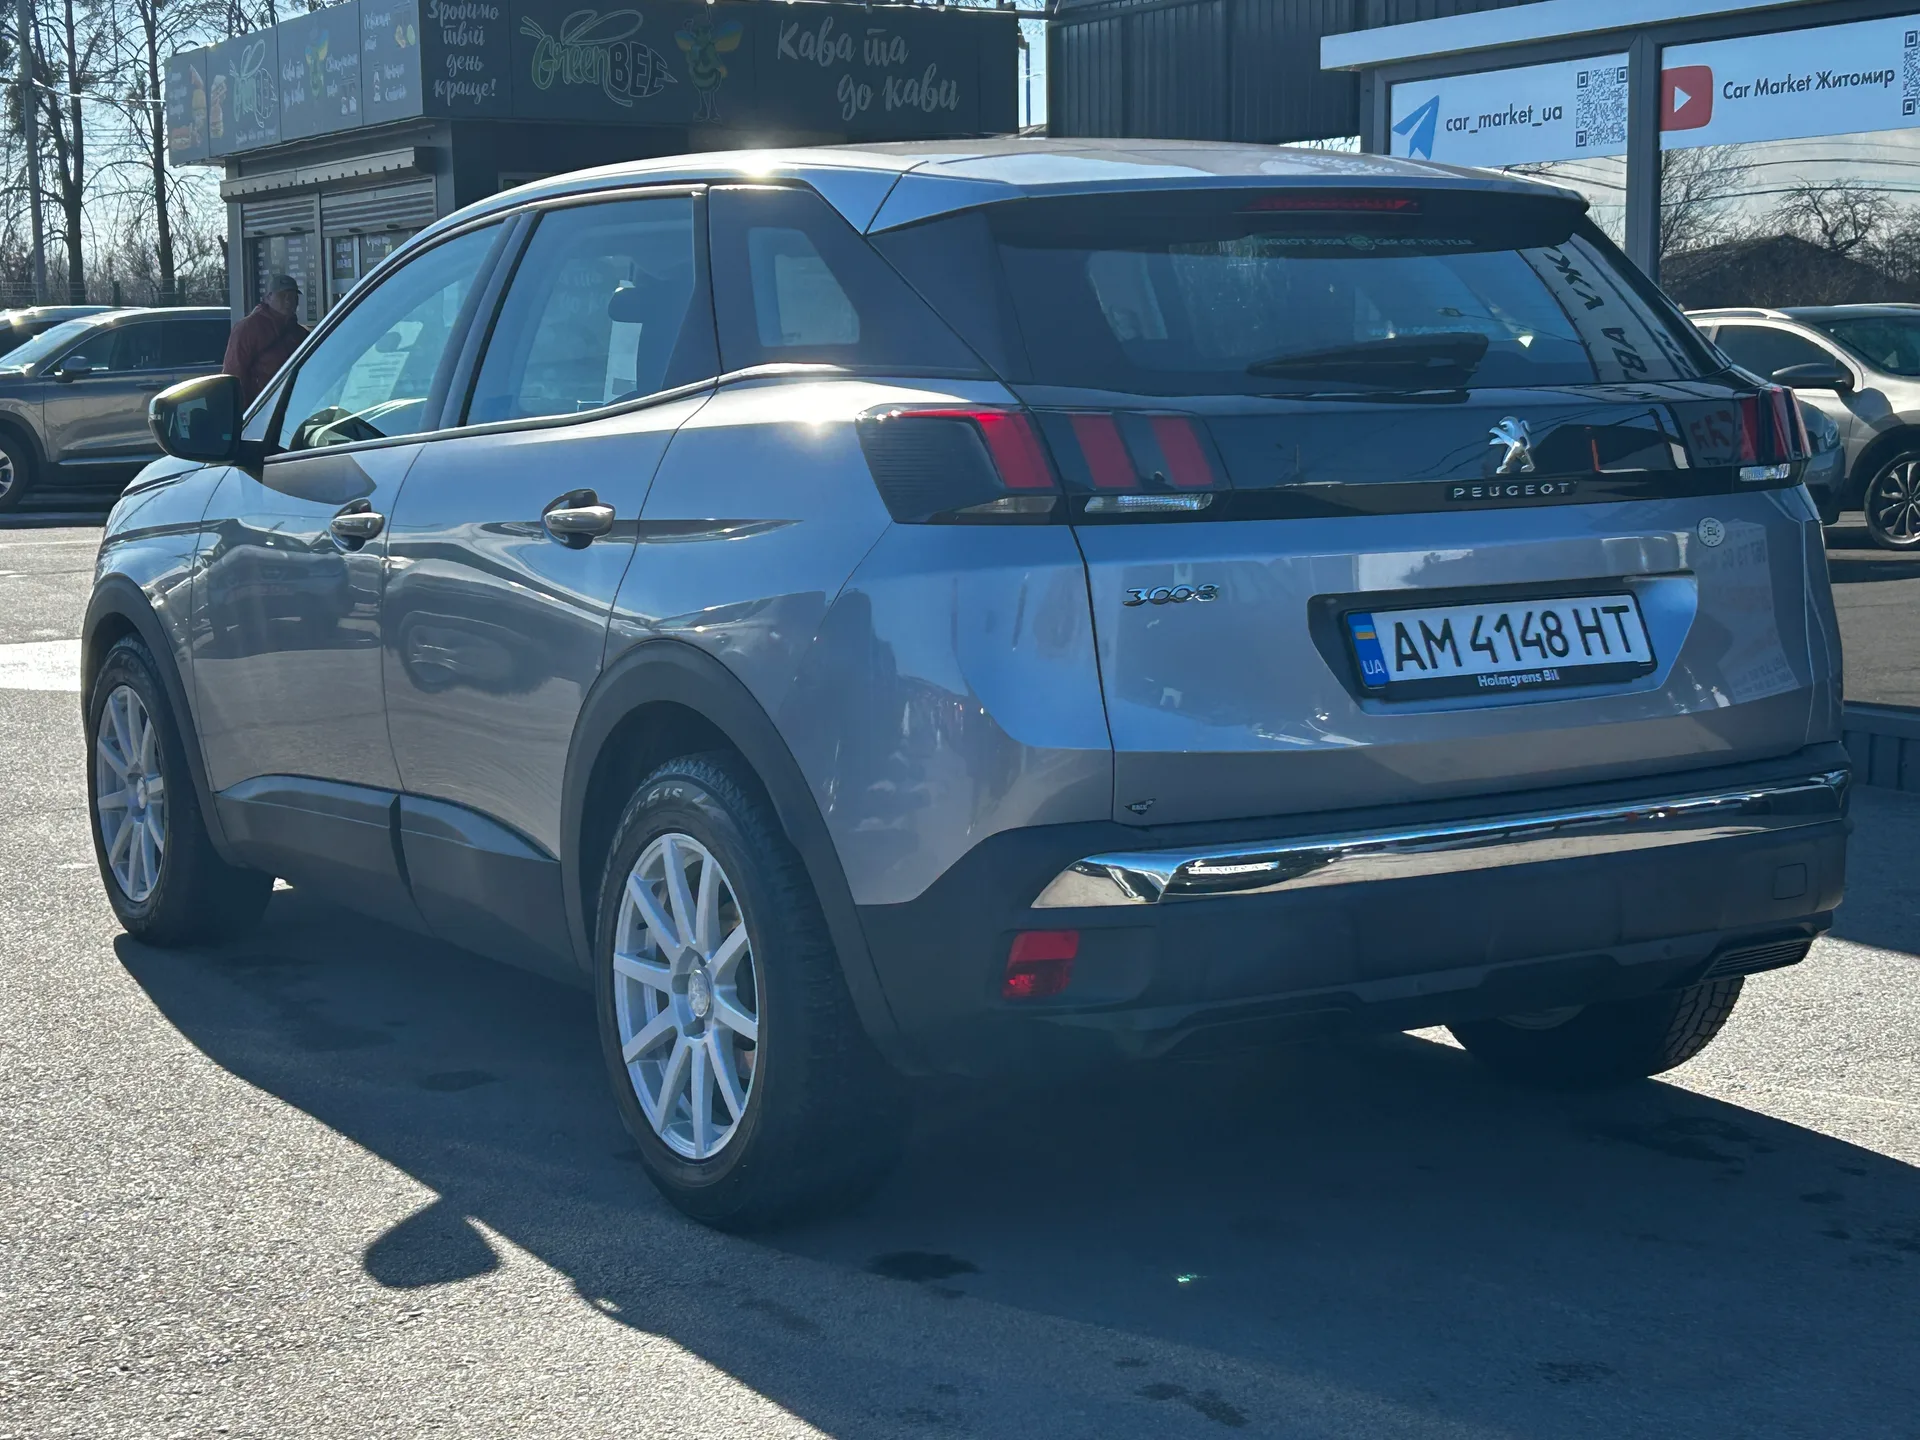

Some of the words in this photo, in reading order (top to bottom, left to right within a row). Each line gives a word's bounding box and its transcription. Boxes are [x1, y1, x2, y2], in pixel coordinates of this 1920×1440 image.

[443, 20, 486, 47] твій
[777, 16, 857, 67] Кава
[863, 28, 910, 67] та
[446, 53, 484, 77] день
[433, 78, 497, 106] краще!
[836, 73, 875, 122] до
[881, 62, 961, 113] кави
[1722, 80, 1751, 100] Car
[1753, 73, 1812, 97] Market
[1815, 68, 1896, 90] Житомир
[1445, 103, 1563, 134] car_market_ua
[1452, 482, 1570, 499] PEUGEOT
[1122, 583, 1220, 607] 3008
[1393, 617, 1463, 673] AM
[1469, 609, 1570, 664] 4148
[1572, 604, 1632, 657] HT
[1362, 658, 1386, 676] UA
[1477, 671, 1542, 688] Holmgrens
[1543, 668, 1560, 681] Bil
